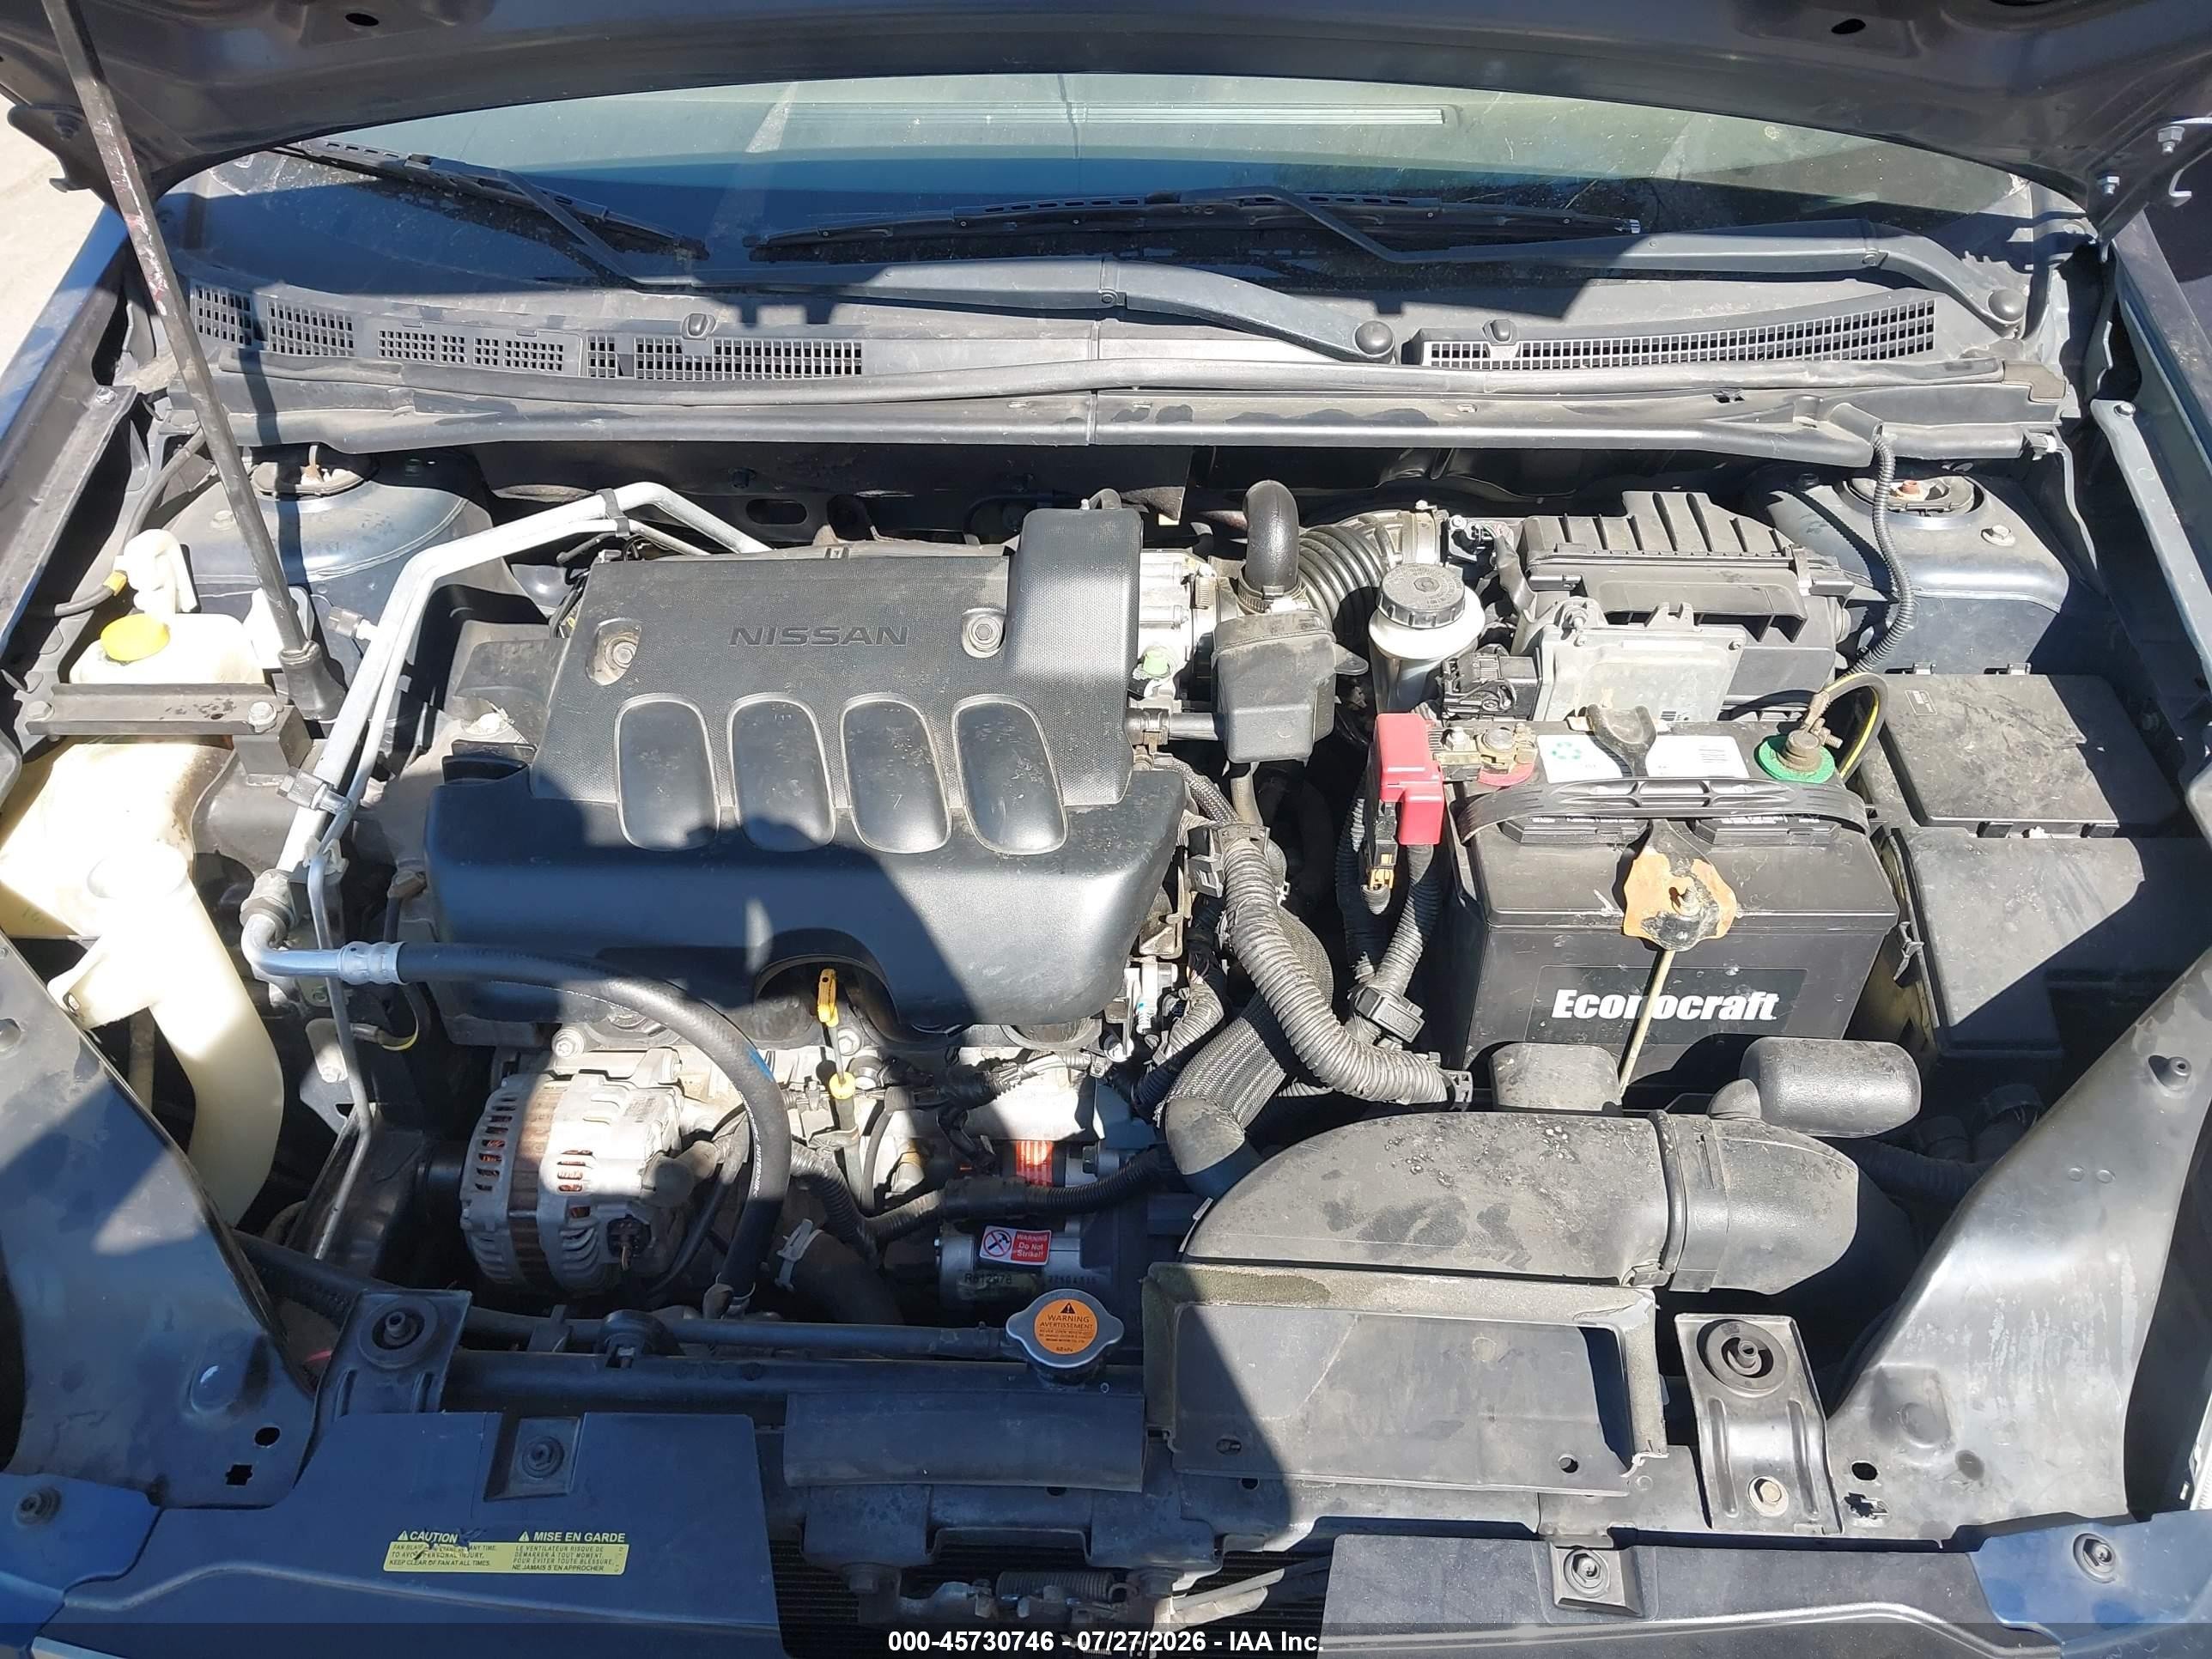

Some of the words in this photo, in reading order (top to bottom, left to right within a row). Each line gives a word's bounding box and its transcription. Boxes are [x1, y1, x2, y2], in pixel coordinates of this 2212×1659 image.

[729, 626, 908, 647] NISSAN
[1017, 1232, 1048, 1241] WARNING
[1018, 1242, 1030, 1250] Do
[1030, 1243, 1043, 1251] Not
[1048, 1314, 1090, 1323] WARNING
[1039, 1321, 1093, 1329] AVERTISSEMENT
[410, 1531, 459, 1543] CAUTION
[532, 1531, 562, 1541] MISE
[565, 1532, 581, 1541] EN
[584, 1532, 626, 1543] GARDE
